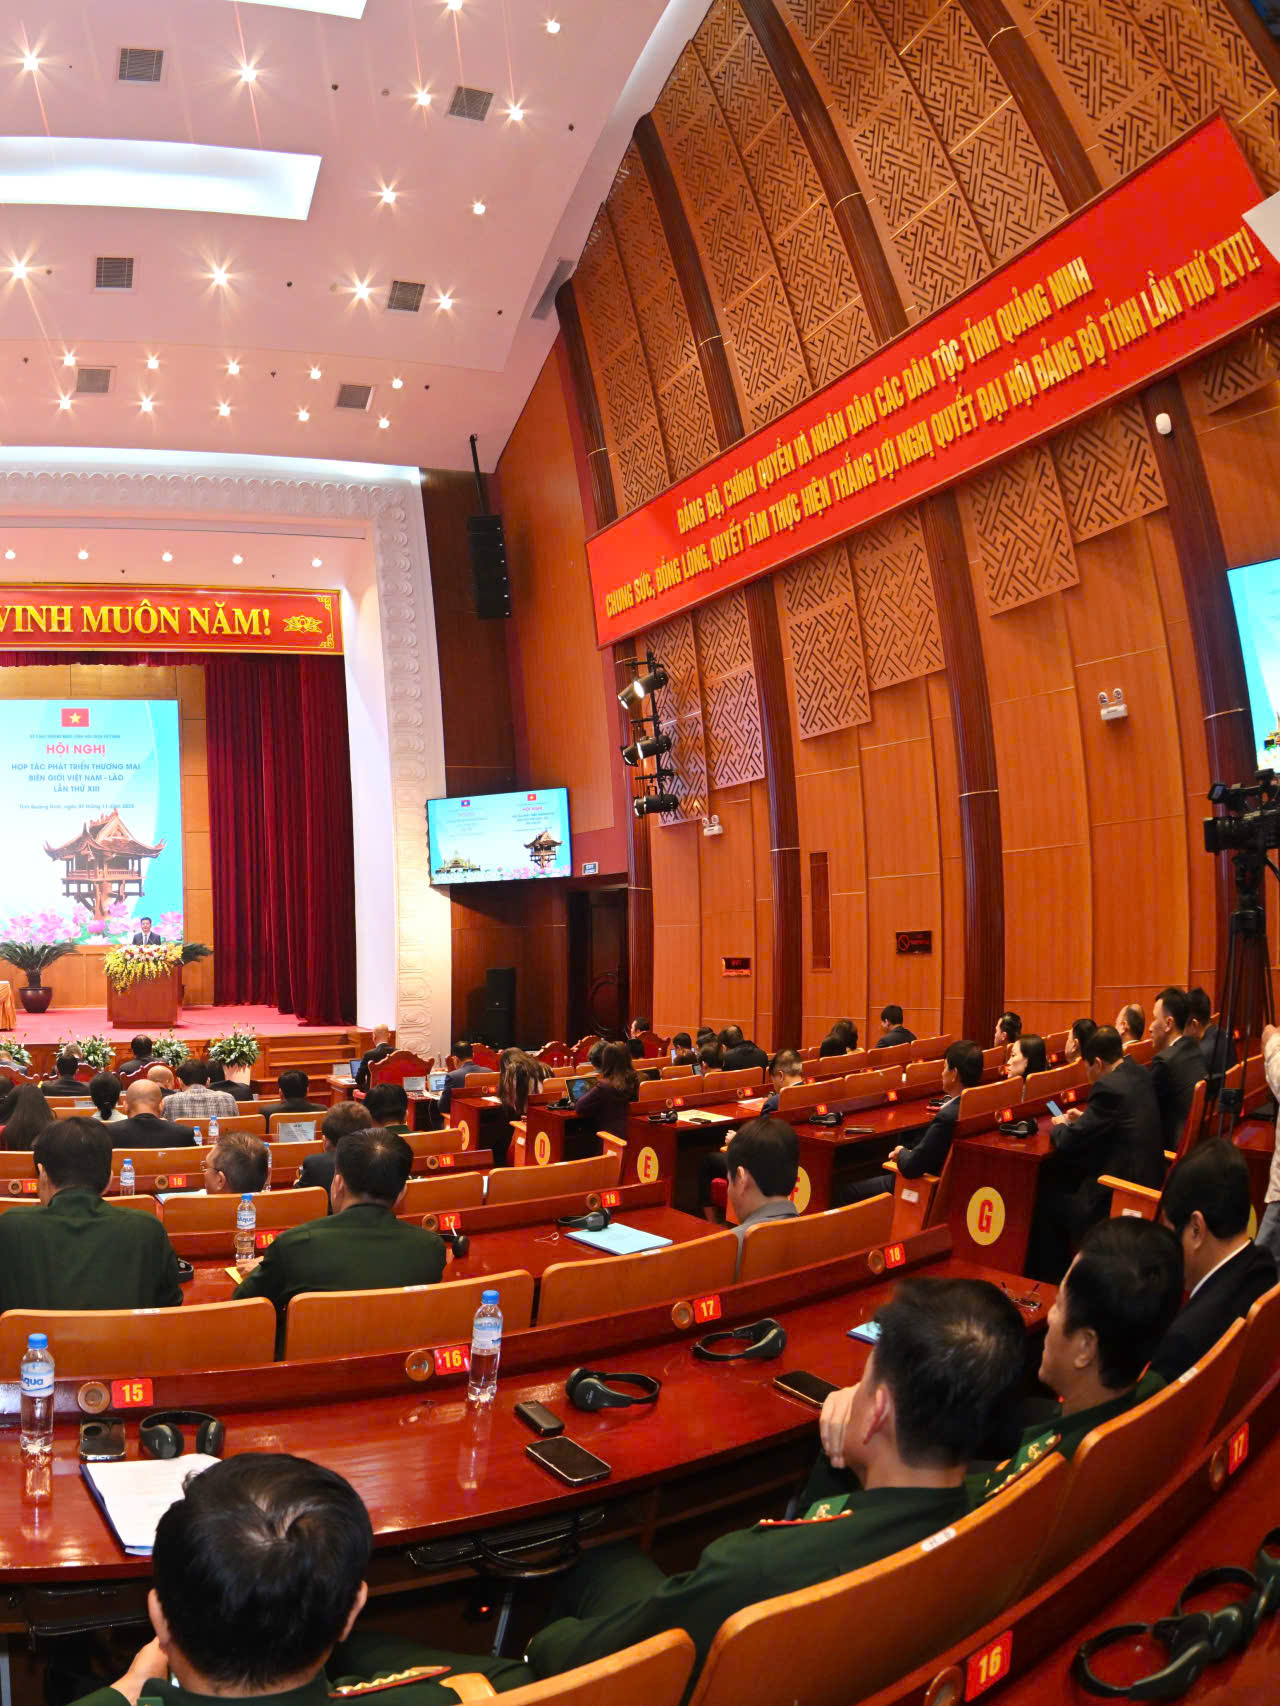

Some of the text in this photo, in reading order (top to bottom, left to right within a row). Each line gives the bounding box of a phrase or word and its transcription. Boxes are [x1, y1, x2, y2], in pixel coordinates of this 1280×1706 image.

[677, 497, 706, 535] ĐẢNG
[724, 468, 757, 507] CHÍNH
[757, 437, 796, 489] QUYỀN
[793, 430, 812, 467] VÀ
[809, 411, 848, 457] NHÂN
[845, 393, 878, 435] DÂN
[874, 376, 904, 417] CÁC
[902, 356, 936, 400] DÂN
[932, 338, 964, 382] TỘC
[960, 315, 1001, 364] TỈNH
[996, 283, 1053, 344] QUẢNG
[1047, 256, 1094, 310] NINH
[605, 583, 634, 618] CHUNG
[710, 518, 744, 565] QUYẾT
[744, 510, 771, 546] TÂM
[769, 492, 802, 533] THỰC
[800, 476, 832, 517] HIỆN
[829, 451, 877, 501] THẮNG
[874, 438, 900, 479] LỢI
[896, 420, 935, 466] NGHỊ
[930, 386, 978, 448] QUYẾT
[976, 377, 1009, 422] ĐẠI
[1004, 358, 1037, 406] HỘI
[1031, 336, 1083, 391] ĐẢNG
[1075, 315, 1107, 366] BỘ
[1099, 296, 1148, 351] TỈNH
[1140, 270, 1184, 328] LẦN
[1174, 249, 1216, 307] THỨ
[1208, 226, 1261, 288] XVI!
[81, 598, 182, 635] MUÔN
[188, 600, 271, 636] NĂM!
[46, 741, 106, 757] HỘI NGHỊ
[644, 1155, 653, 1179] E
[978, 1199, 994, 1234] G
[889, 1246, 900, 1262] 18
[701, 1300, 714, 1317] 17
[443, 1350, 462, 1368] 16
[122, 1384, 144, 1402] 15
[1234, 1433, 1245, 1462] 17
[979, 1646, 1002, 1684] 16
